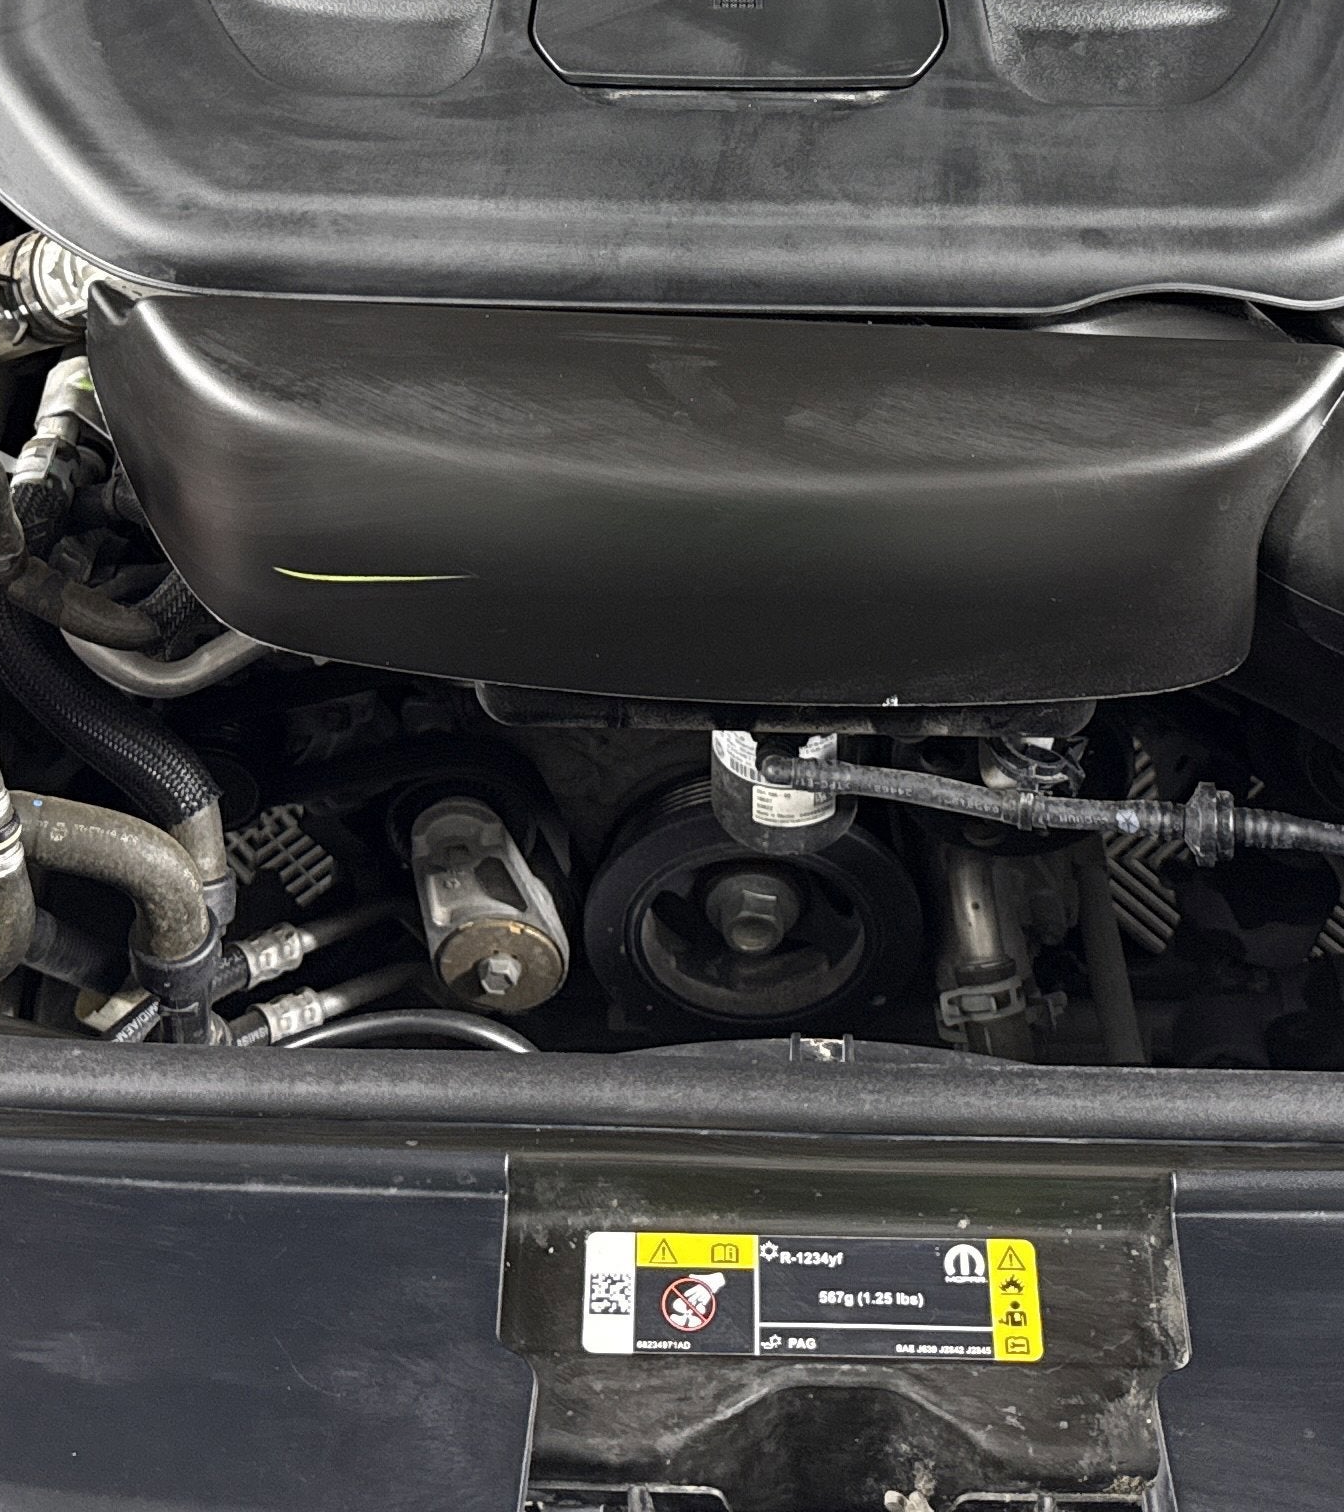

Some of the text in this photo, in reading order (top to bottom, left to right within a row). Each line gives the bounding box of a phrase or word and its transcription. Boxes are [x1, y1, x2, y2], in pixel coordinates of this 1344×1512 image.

[779, 1251, 844, 1267] R-1234yf
[818, 1290, 924, 1308] 567g (1.25 lbs)
[788, 1338, 817, 1350] PAG
